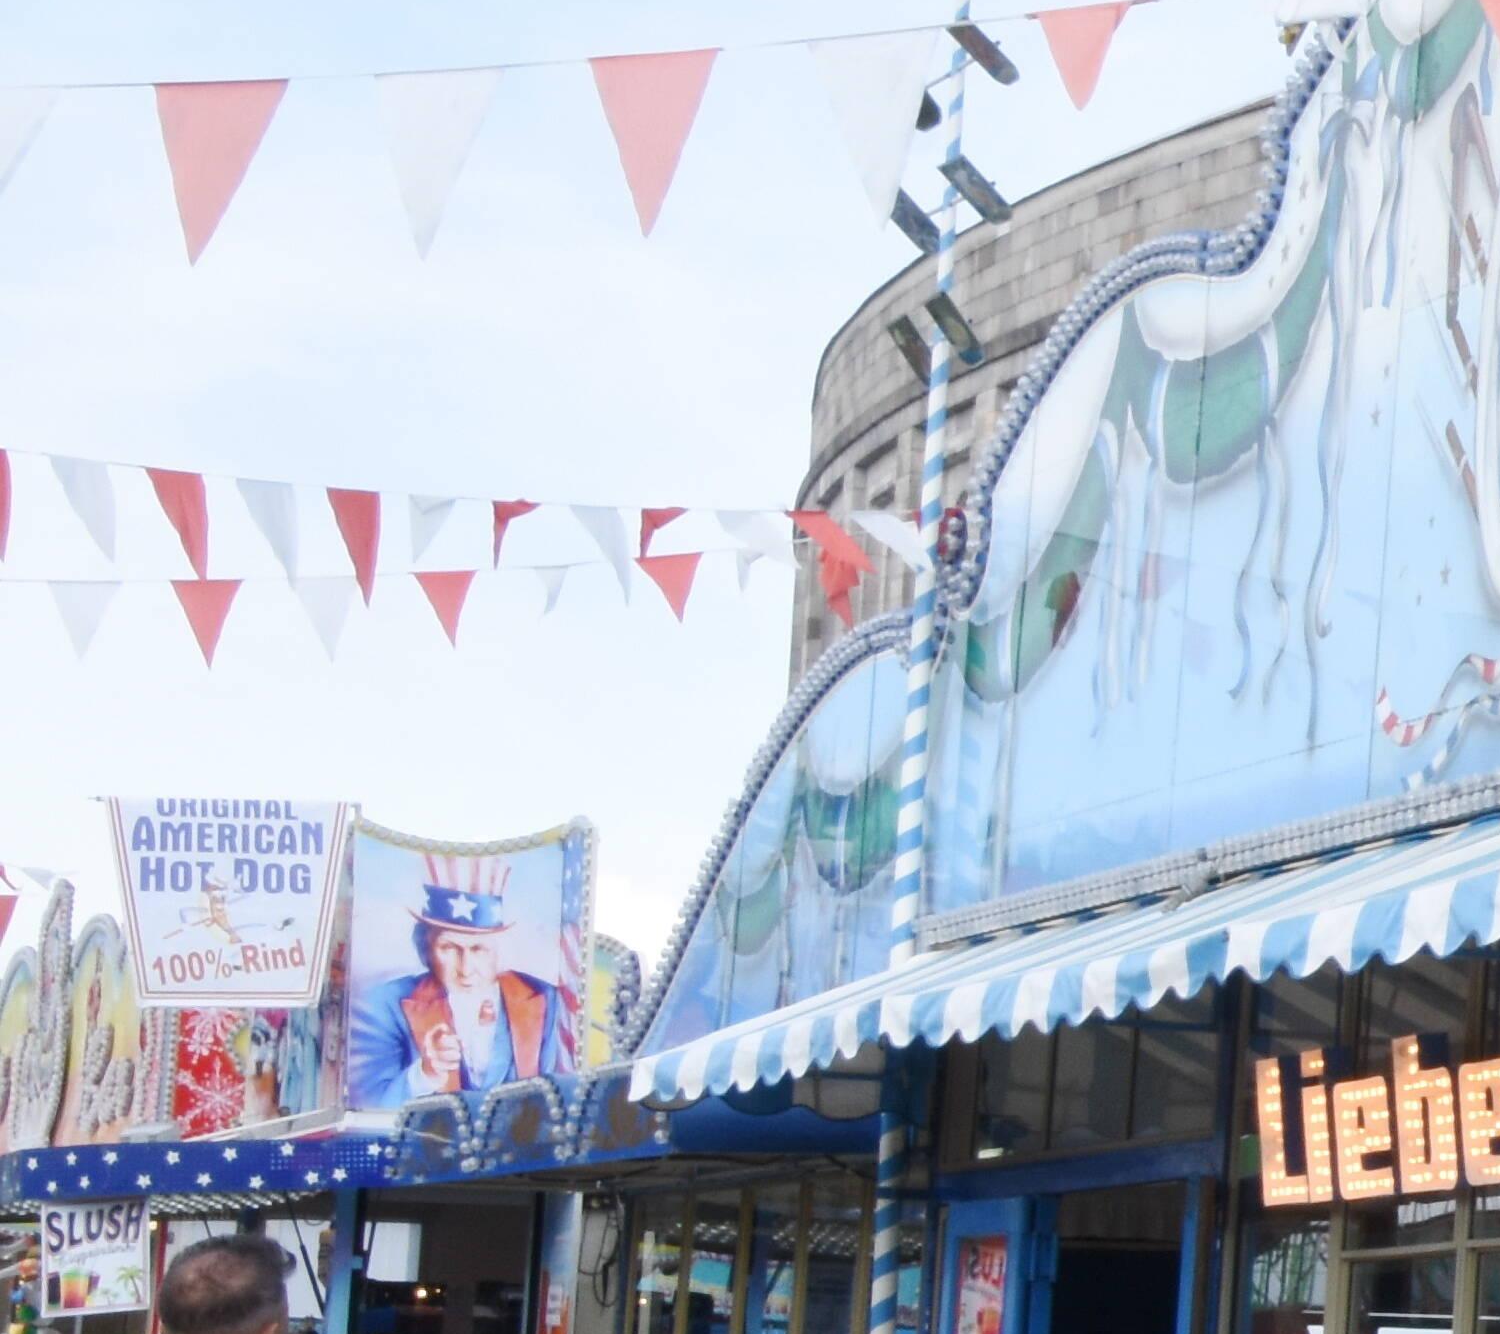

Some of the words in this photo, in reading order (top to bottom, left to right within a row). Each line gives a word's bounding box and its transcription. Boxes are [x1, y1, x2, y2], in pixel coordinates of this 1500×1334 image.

[156, 797, 298, 820] ORIGINAL
[131, 816, 324, 855] AMERICAN
[139, 856, 215, 893] HOT
[234, 858, 312, 894] DOG
[153, 947, 233, 986] 100%
[240, 938, 306, 975] Rind
[46, 1202, 146, 1254] SLUSH
